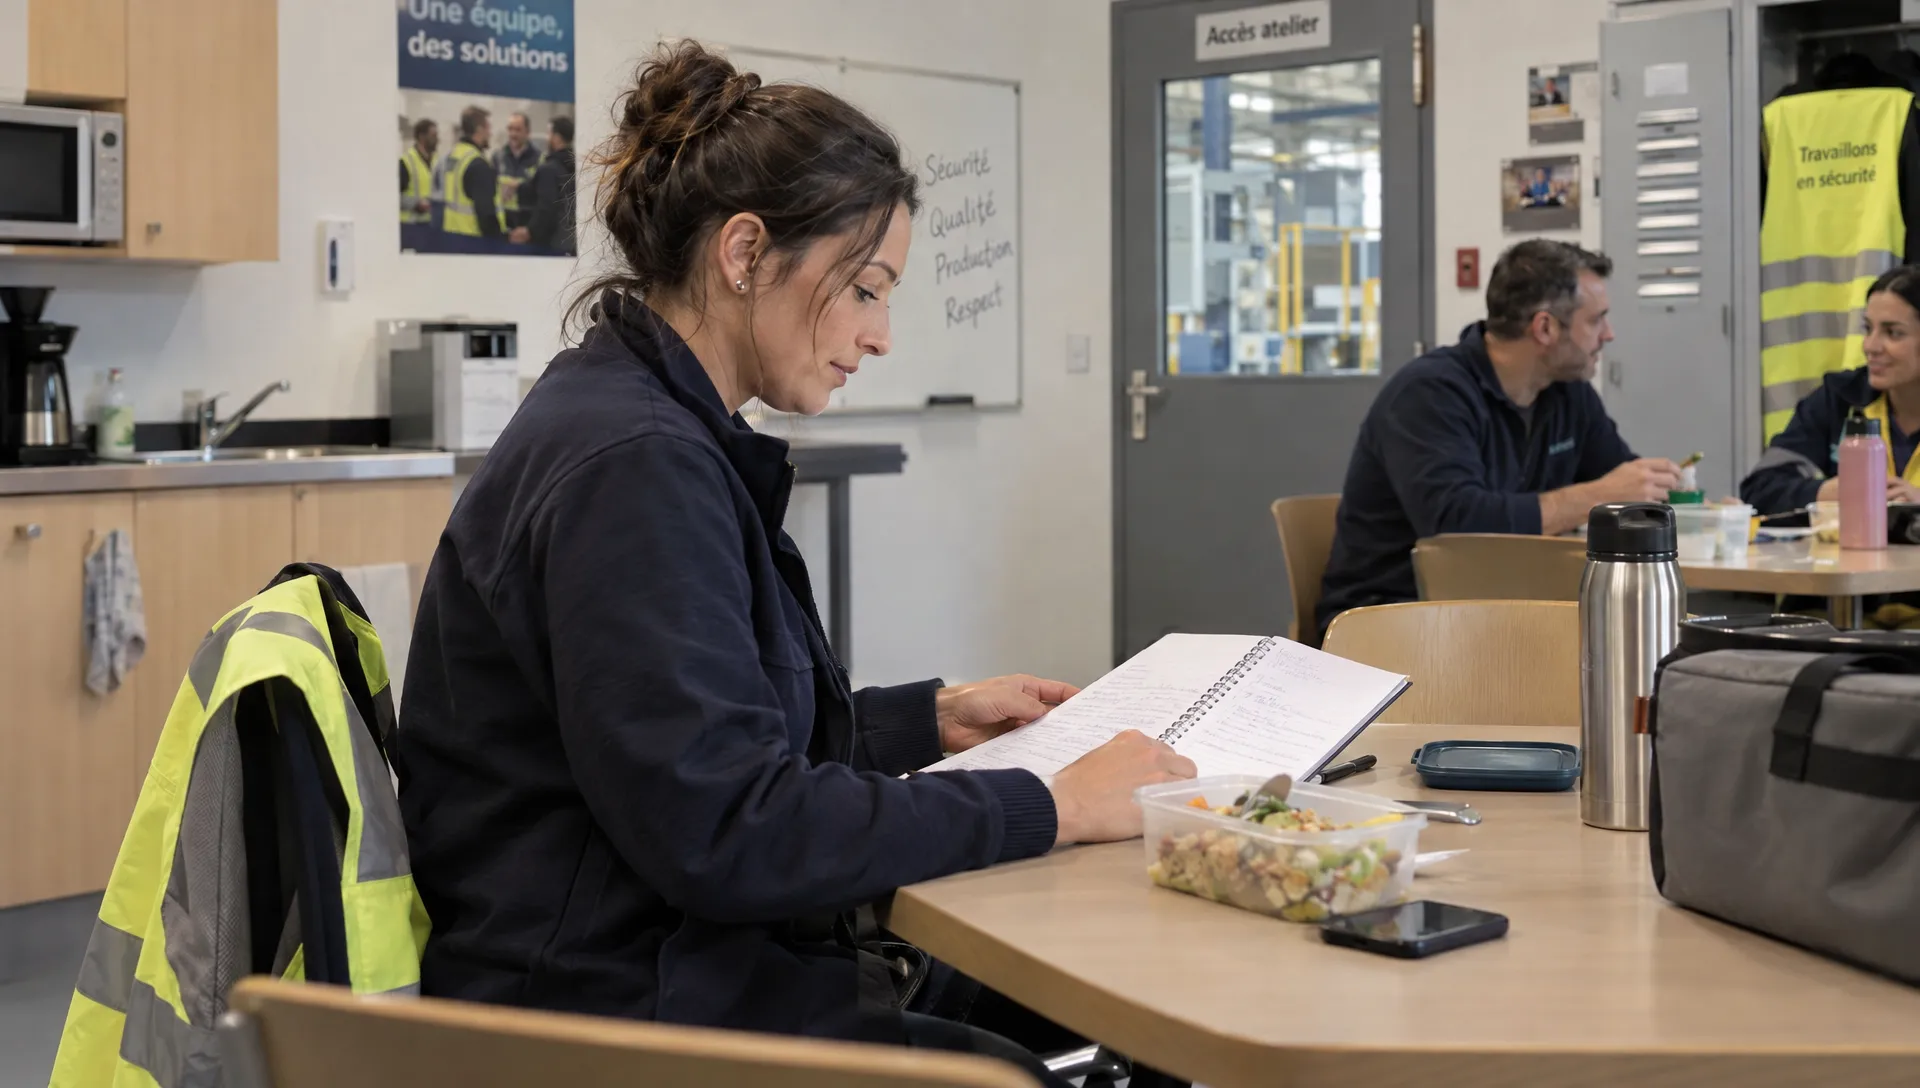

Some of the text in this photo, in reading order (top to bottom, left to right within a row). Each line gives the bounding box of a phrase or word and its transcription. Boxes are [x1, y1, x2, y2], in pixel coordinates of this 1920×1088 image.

[408, 0, 564, 40] Une équipe,
[1205, 14, 1320, 46] Accès atelier
[407, 29, 569, 73] des solutions
[925, 147, 991, 187] Sécurité
[1799, 142, 1877, 163] Travaillons
[1796, 164, 1877, 190] en sécurité
[930, 189, 996, 239] Qualité
[935, 238, 1014, 285] Production
[945, 280, 1004, 330] Respect
